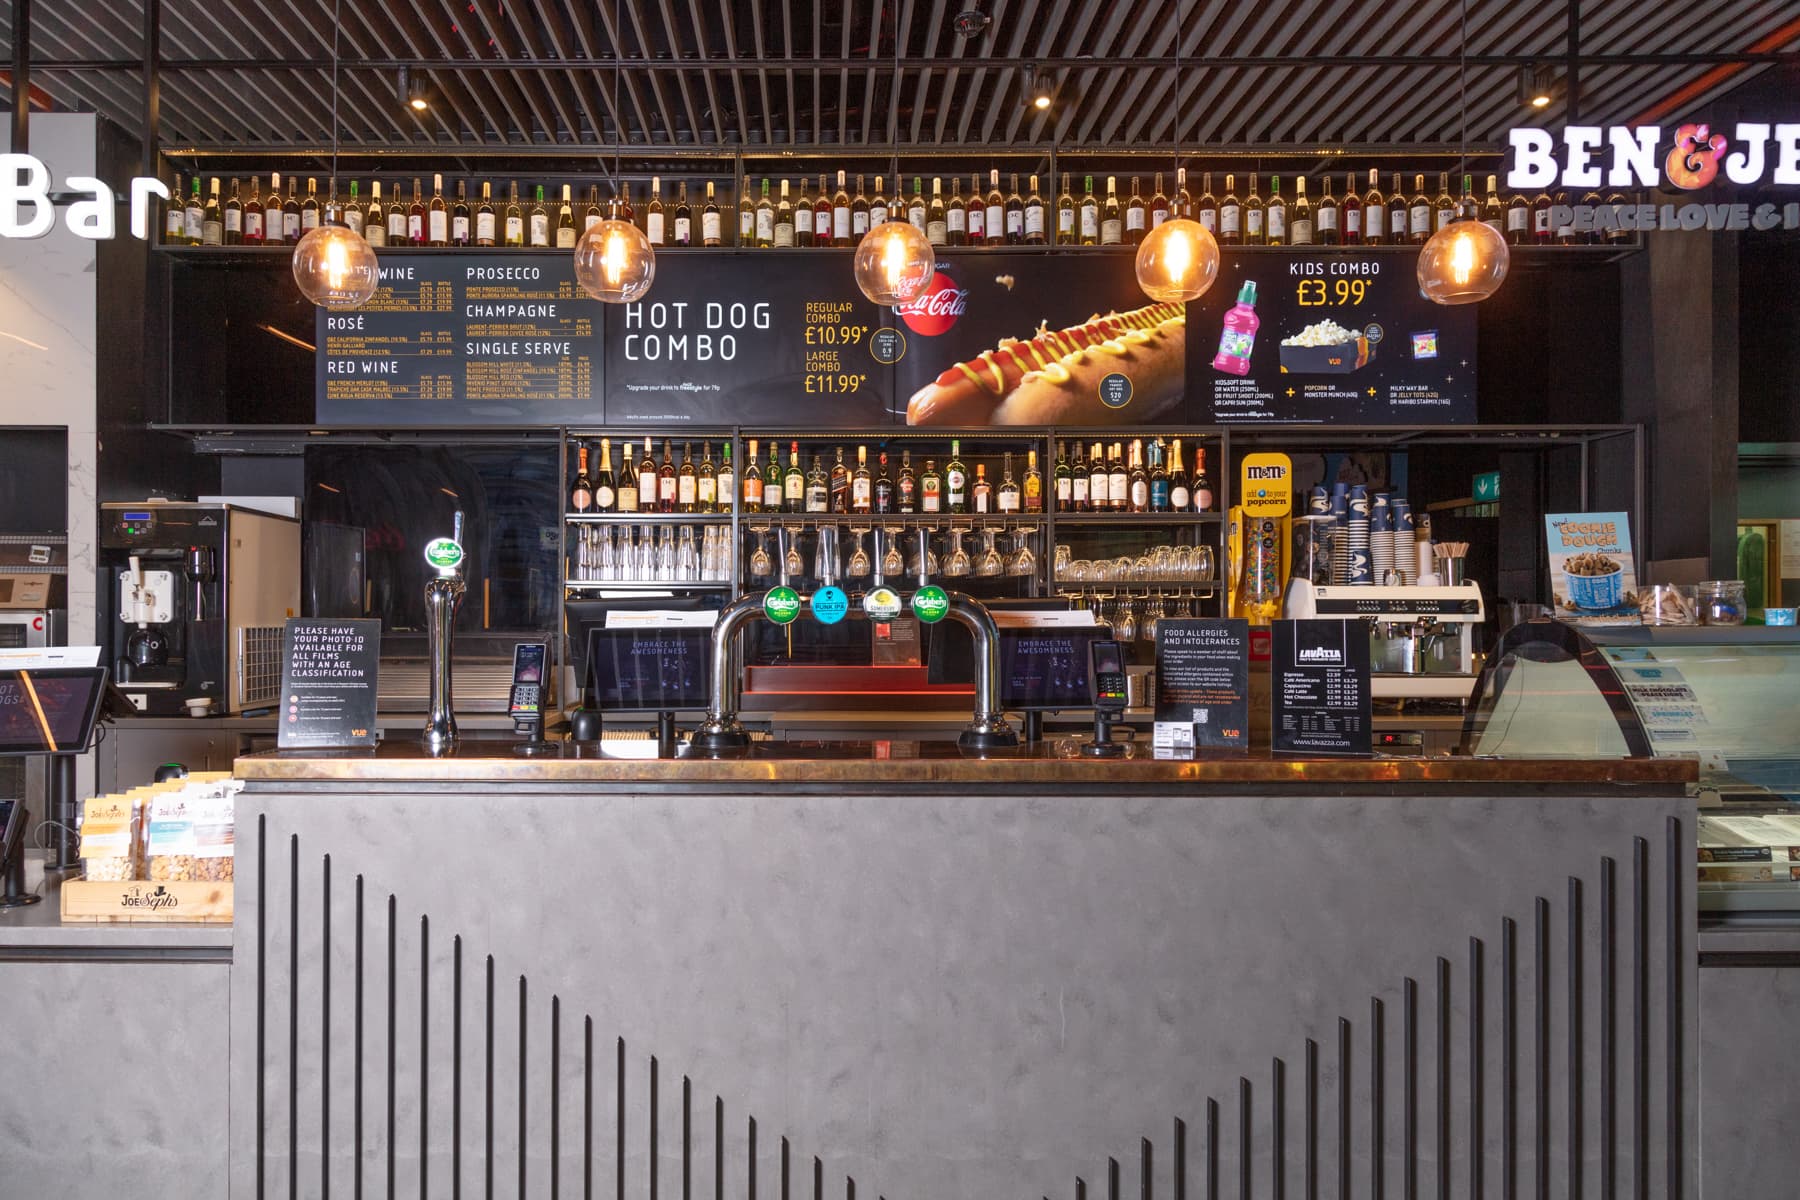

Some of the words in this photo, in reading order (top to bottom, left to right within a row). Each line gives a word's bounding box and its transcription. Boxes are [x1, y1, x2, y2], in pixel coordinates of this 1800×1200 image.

[0, 153, 170, 240] Bar
[1549, 203, 1657, 232] PEACE
[1660, 203, 1750, 232] LOVE
[378, 267, 415, 280] WINE
[466, 267, 540, 280] PROSECCO
[1290, 262, 1324, 275] KIDS
[1330, 262, 1380, 275] COMBO
[466, 304, 557, 318] CHAMPAGNE
[806, 302, 853, 312] REGULAR
[626, 302, 688, 329] HOT
[706, 302, 770, 329] DOG
[806, 314, 841, 324] COMBO
[327, 315, 365, 330] ROSÉ
[466, 342, 519, 355] SINGLE
[524, 342, 571, 355] SERVE
[625, 334, 736, 360] COMBO
[806, 352, 838, 361] LARGE
[328, 362, 356, 374] RED
[362, 362, 398, 374] WINE
[806, 362, 841, 372] COMBO
[1560, 522, 1617, 534] COOKIE
[1562, 534, 1618, 548] DOUGH
[294, 626, 328, 634] PLEASE
[331, 627, 355, 635] HAVE
[1299, 646, 1341, 658] LAVAZZA
